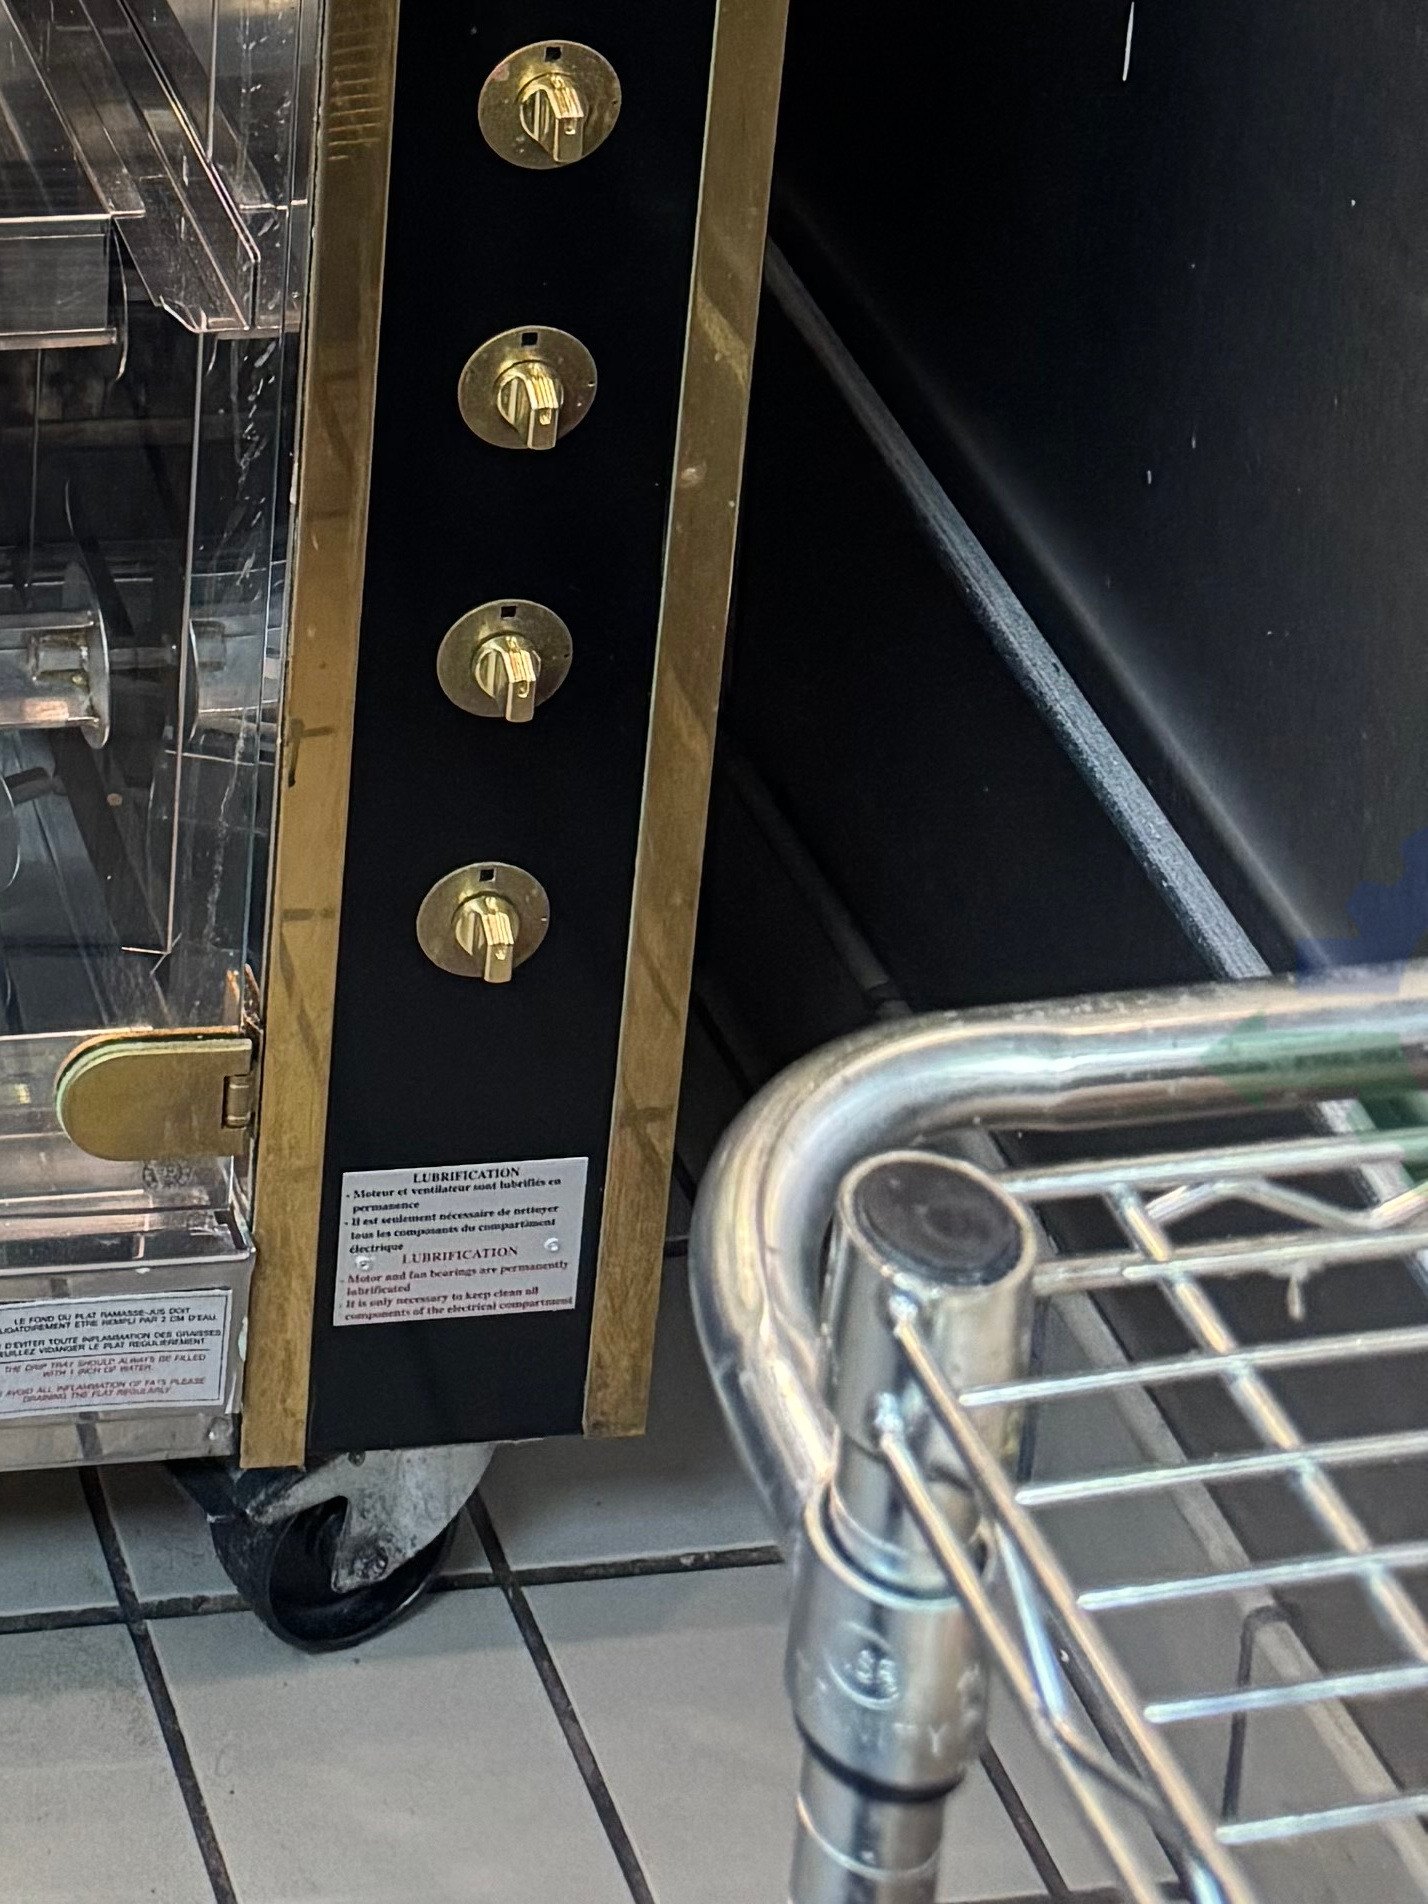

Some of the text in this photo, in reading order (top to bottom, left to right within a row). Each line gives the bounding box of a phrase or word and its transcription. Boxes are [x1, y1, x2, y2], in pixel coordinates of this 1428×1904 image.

[413, 1166, 519, 1183] LUBRIFICATION
[353, 1188, 394, 1199] Moteur
[397, 1187, 408, 1196] et
[411, 1183, 470, 1195] ventilateur
[402, 1246, 517, 1263] LUBRIFICATION
